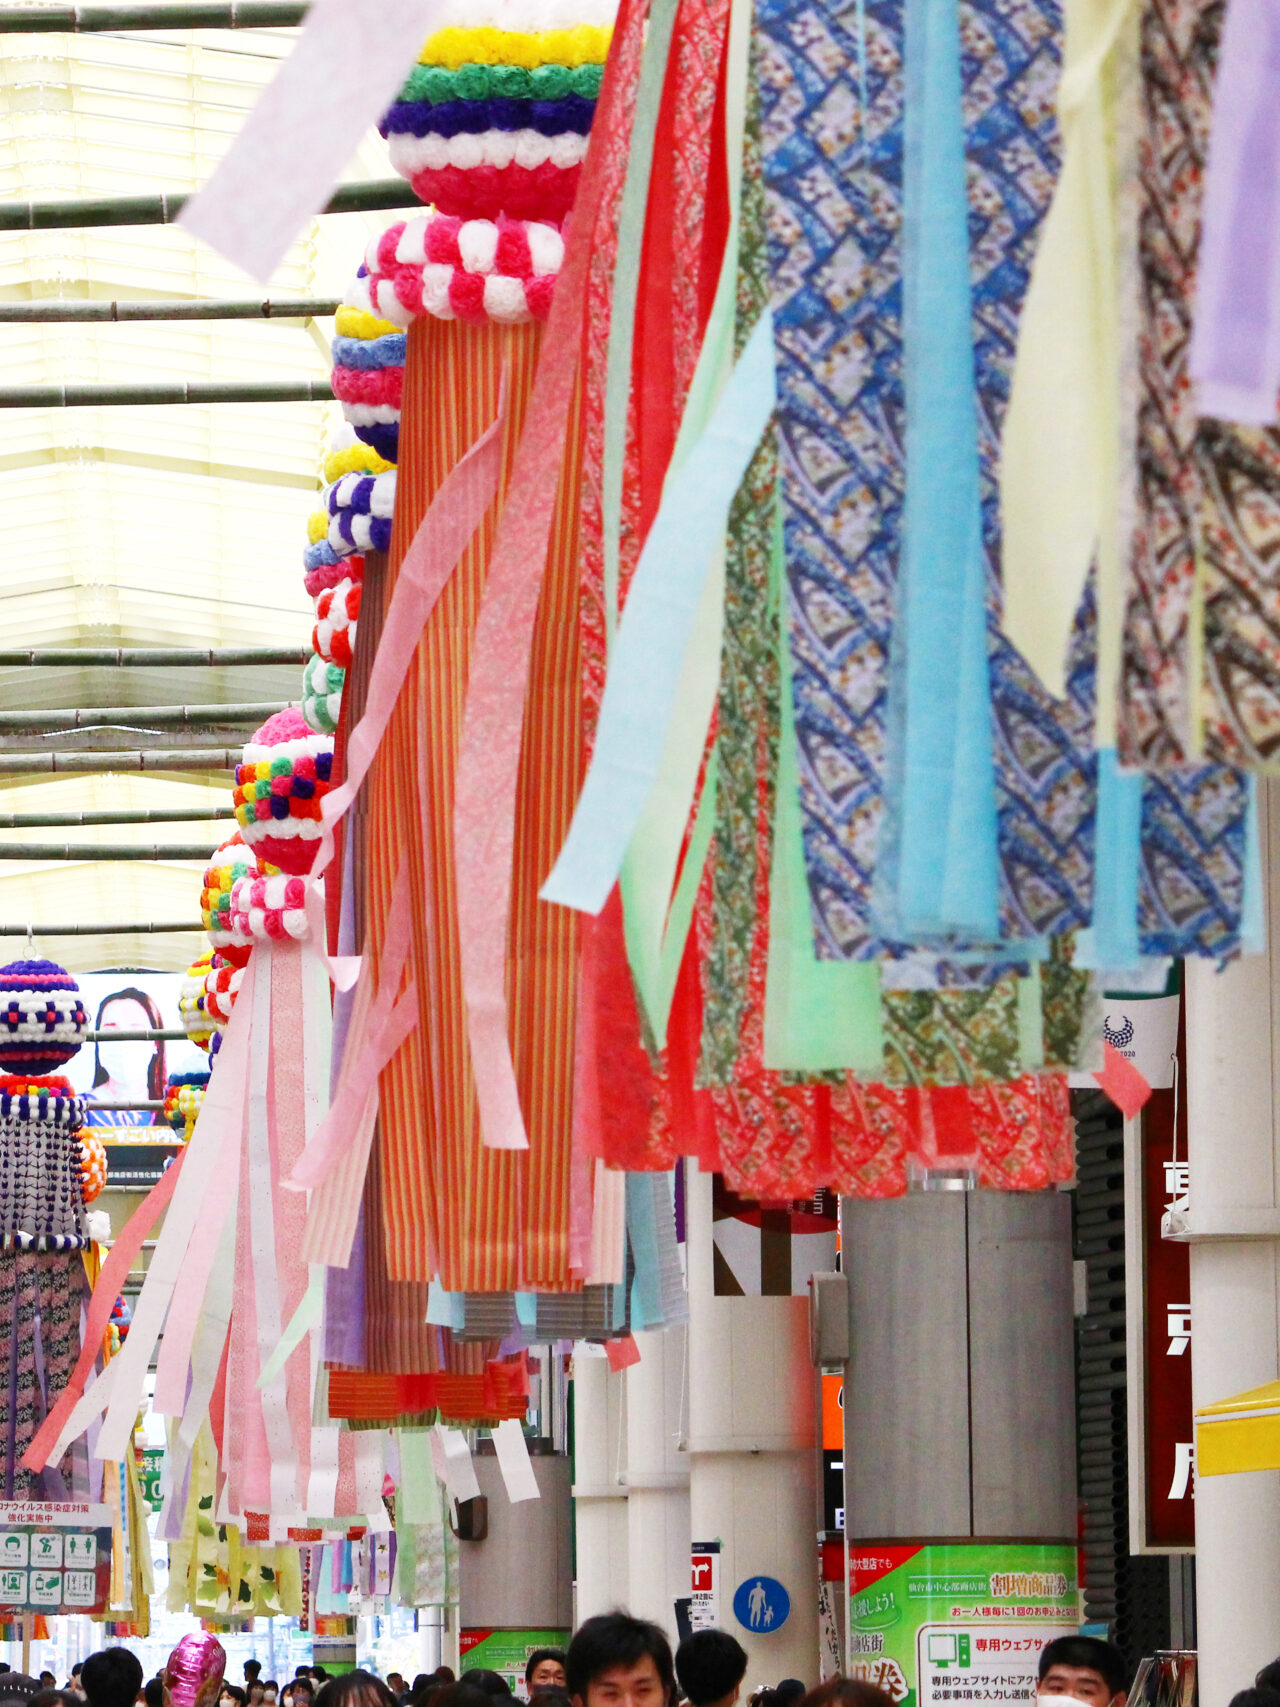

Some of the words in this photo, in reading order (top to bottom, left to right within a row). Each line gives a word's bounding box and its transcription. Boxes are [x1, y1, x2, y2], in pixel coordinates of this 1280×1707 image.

[7, 1513, 53, 1524] 強化実施中
[990, 1573, 1068, 1597] 割増商品券
